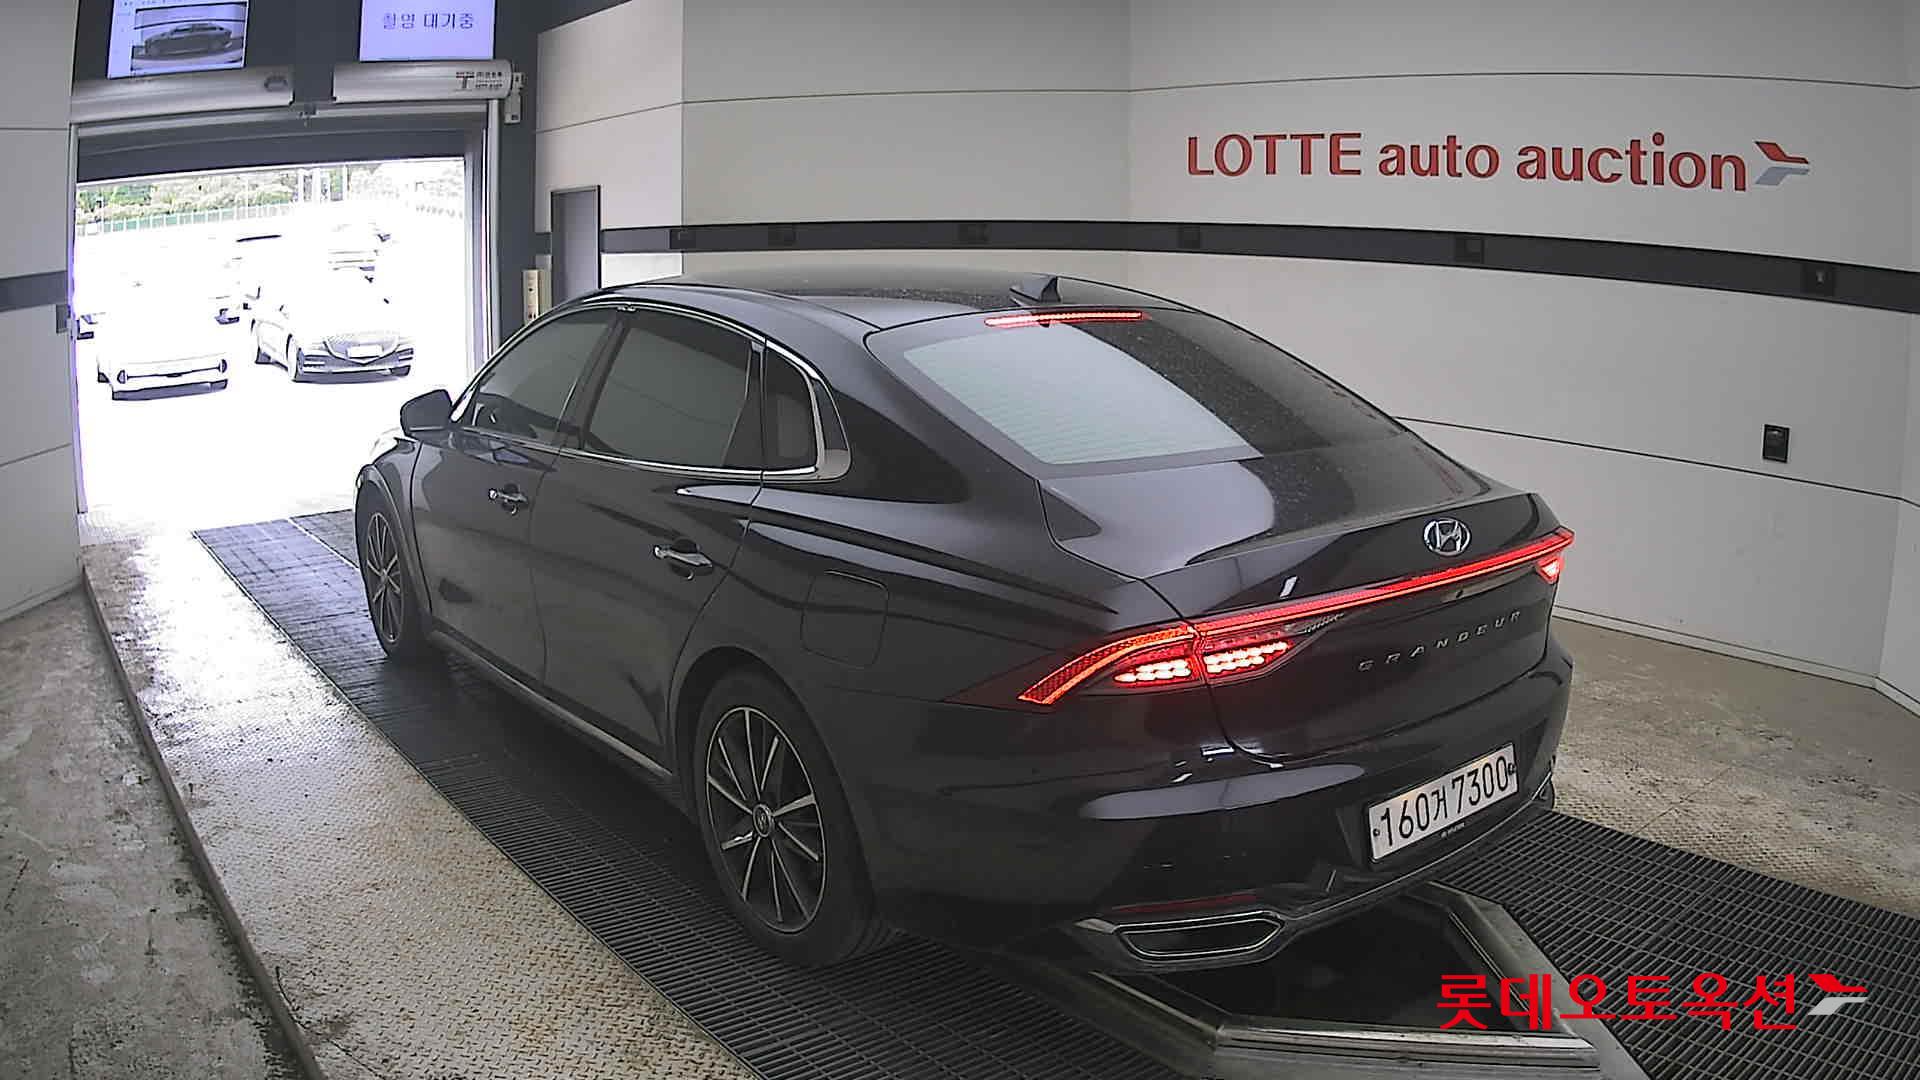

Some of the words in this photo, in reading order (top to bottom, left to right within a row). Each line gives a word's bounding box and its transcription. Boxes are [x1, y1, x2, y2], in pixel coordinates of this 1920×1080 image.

[423, 12, 473, 30] 대기중
[1187, 132, 1362, 177] LOTTE
[1378, 134, 1501, 179] auto
[1516, 132, 1747, 192] auction
[1358, 610, 1521, 672] GRANDEUR
